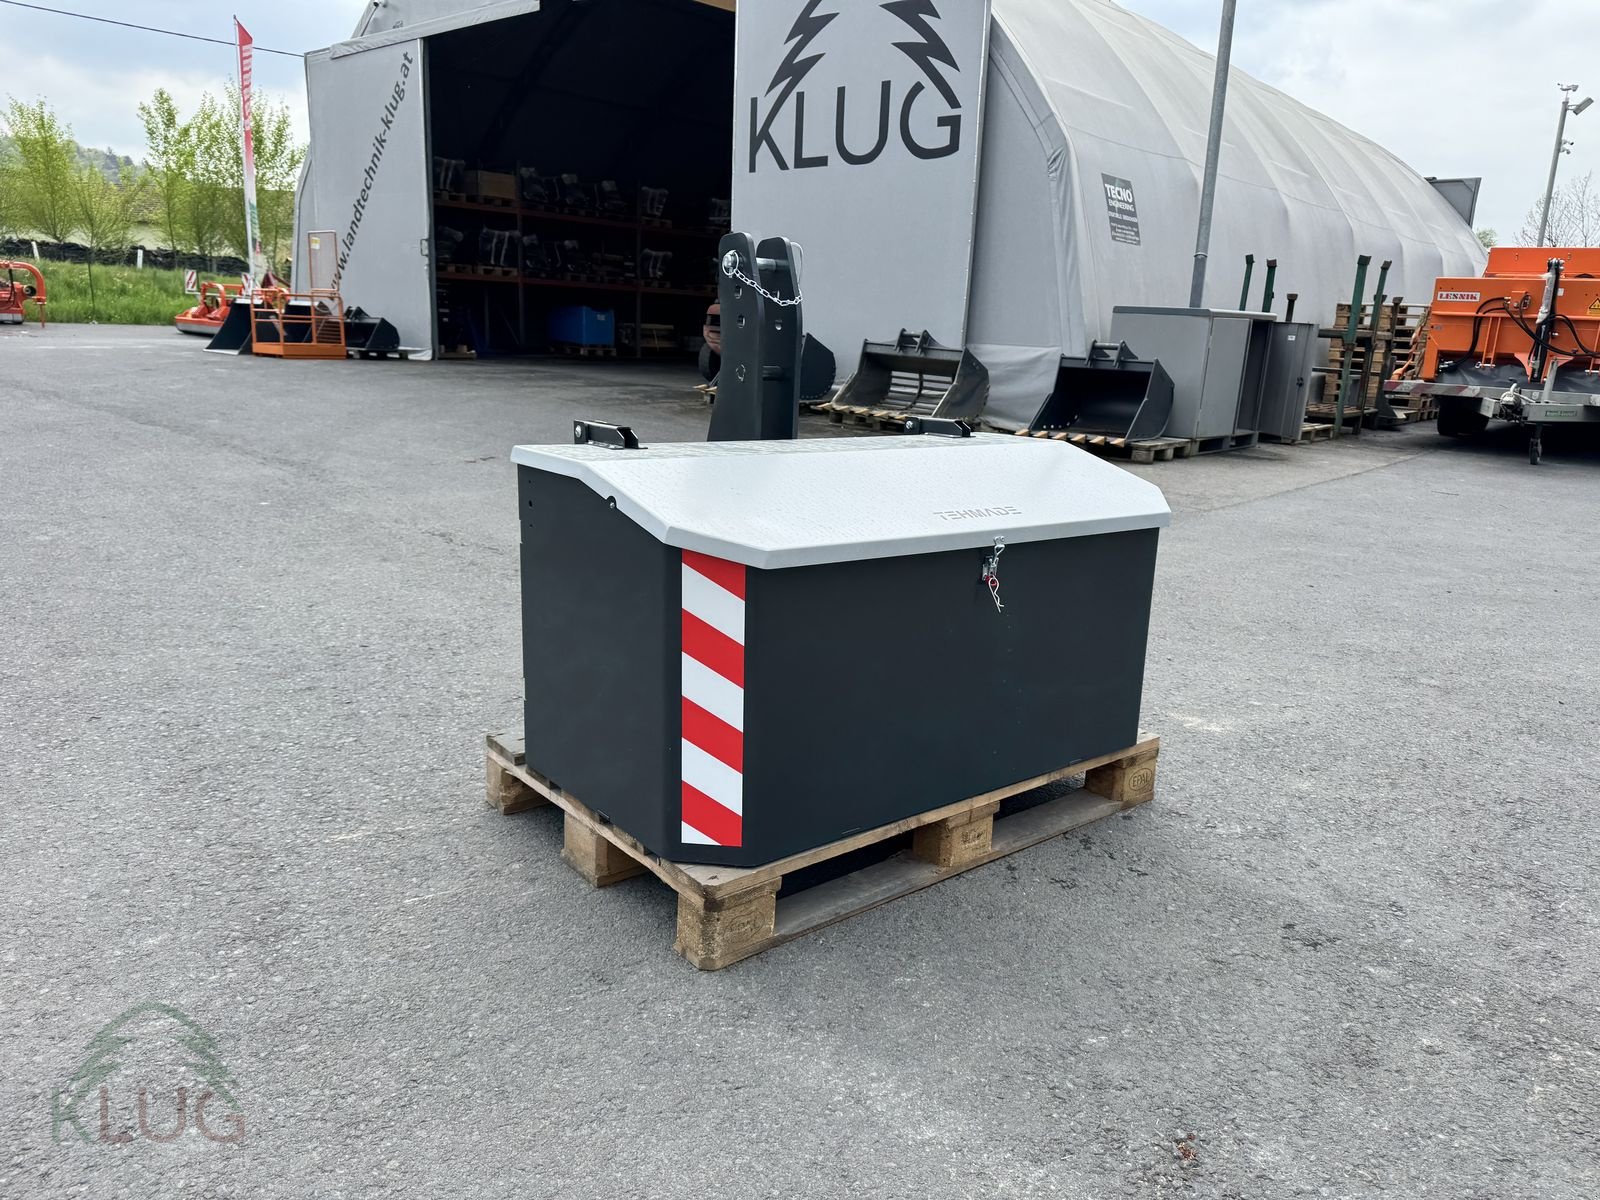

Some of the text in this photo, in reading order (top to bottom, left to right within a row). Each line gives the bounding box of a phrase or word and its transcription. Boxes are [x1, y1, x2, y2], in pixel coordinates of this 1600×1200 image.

[749, 80, 962, 173] KLUG
[1105, 184, 1133, 203] TECNO
[933, 506, 1022, 521] TEHMADE
